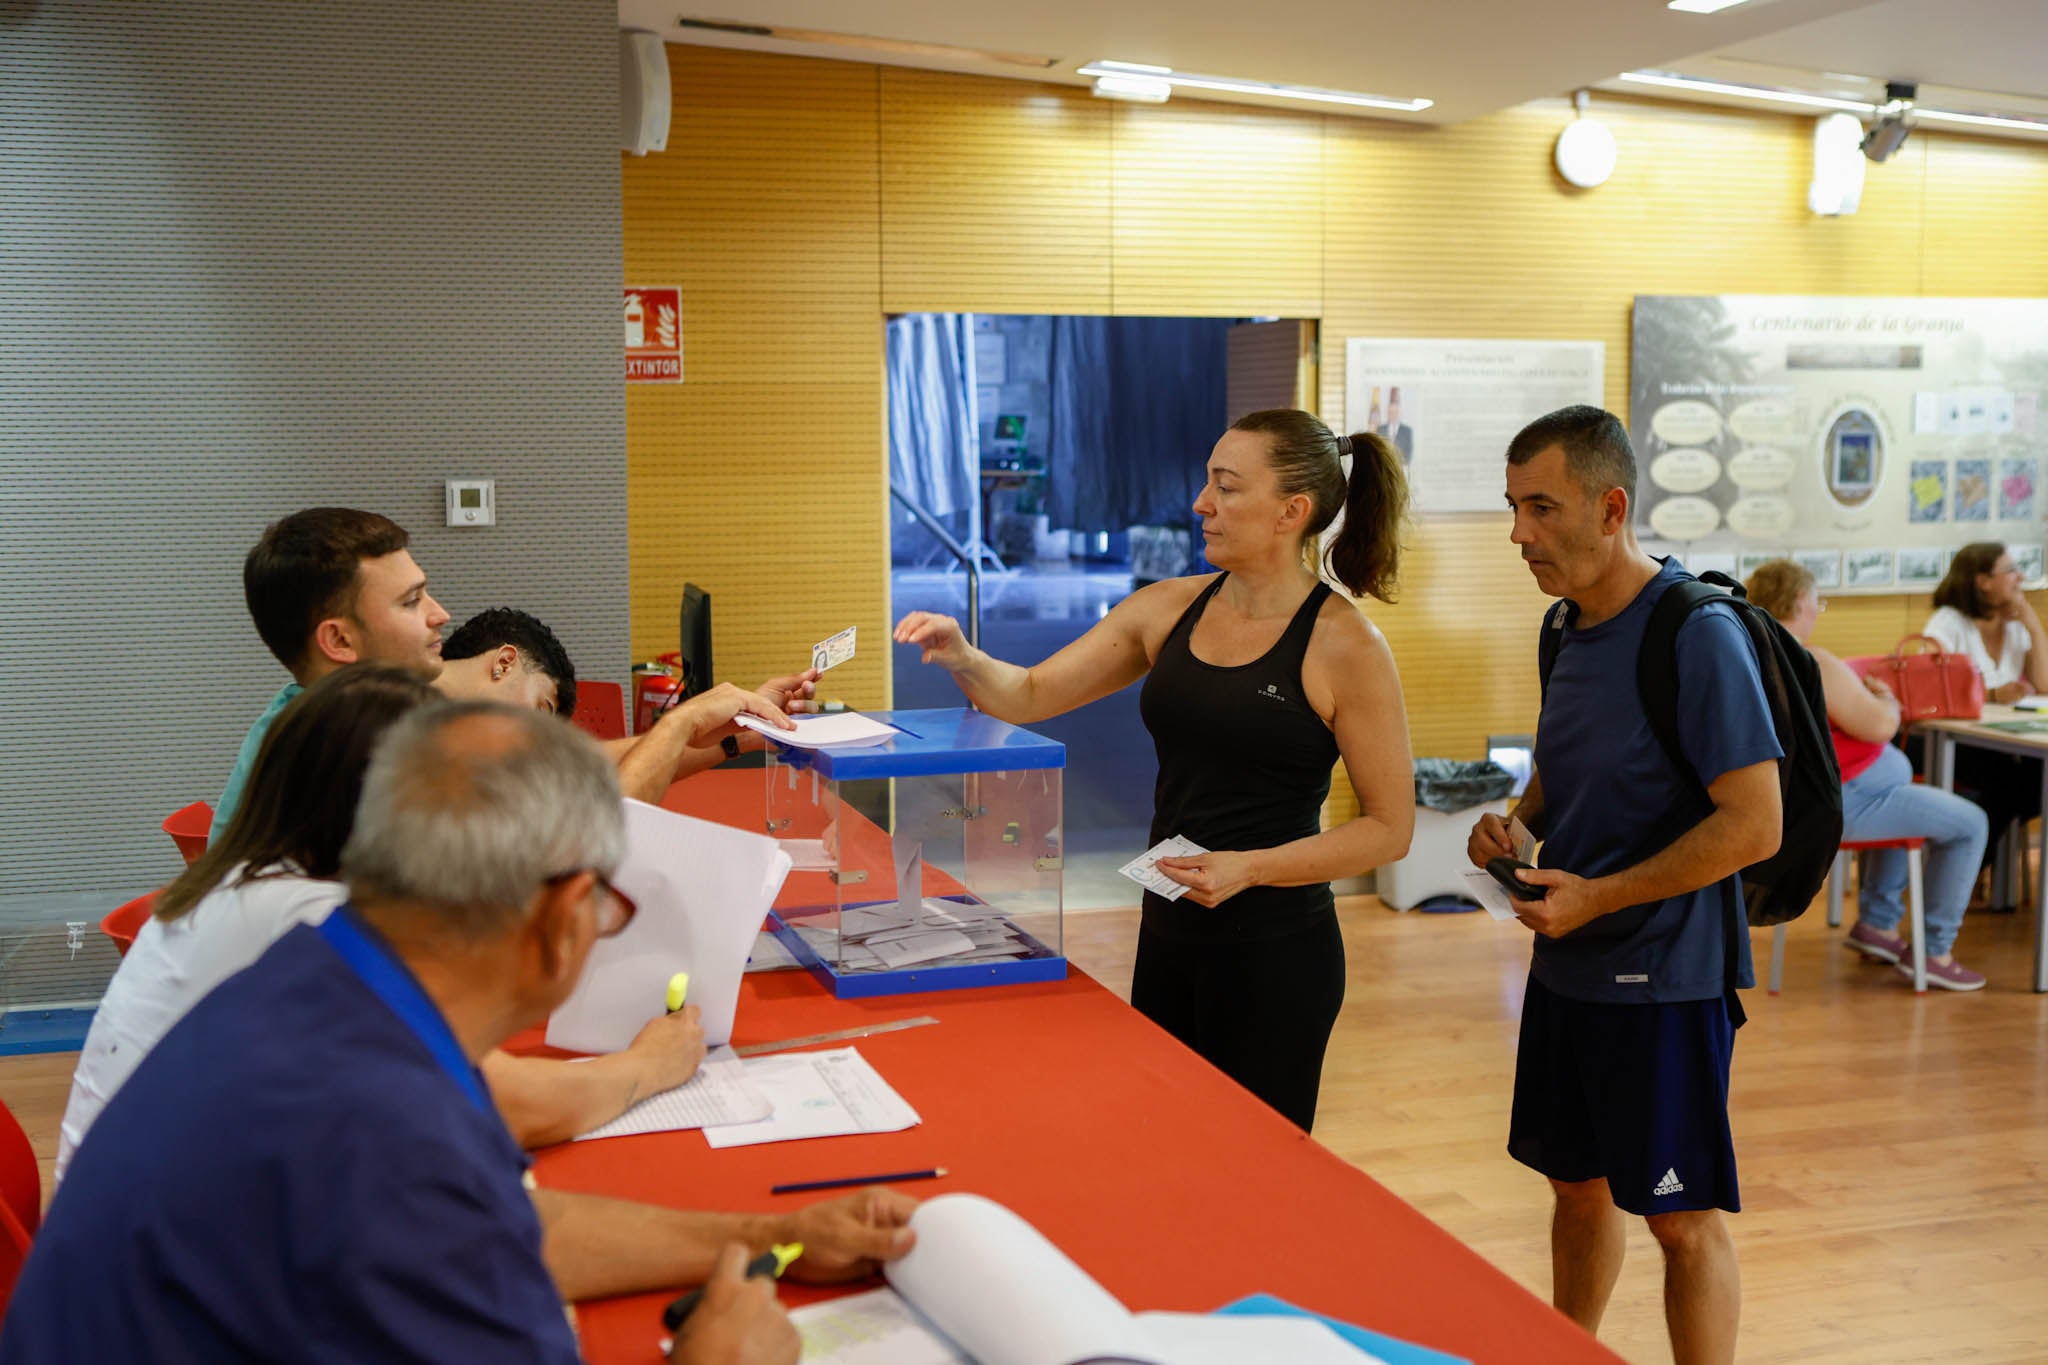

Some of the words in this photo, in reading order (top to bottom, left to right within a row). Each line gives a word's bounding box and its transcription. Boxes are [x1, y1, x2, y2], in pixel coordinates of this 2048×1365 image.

[1749, 313, 1852, 332] Centenario
[1855, 312, 1876, 332] de
[1881, 312, 1899, 332] la
[626, 359, 679, 375] XTINTOR
[1653, 1183, 1684, 1196] adidas
